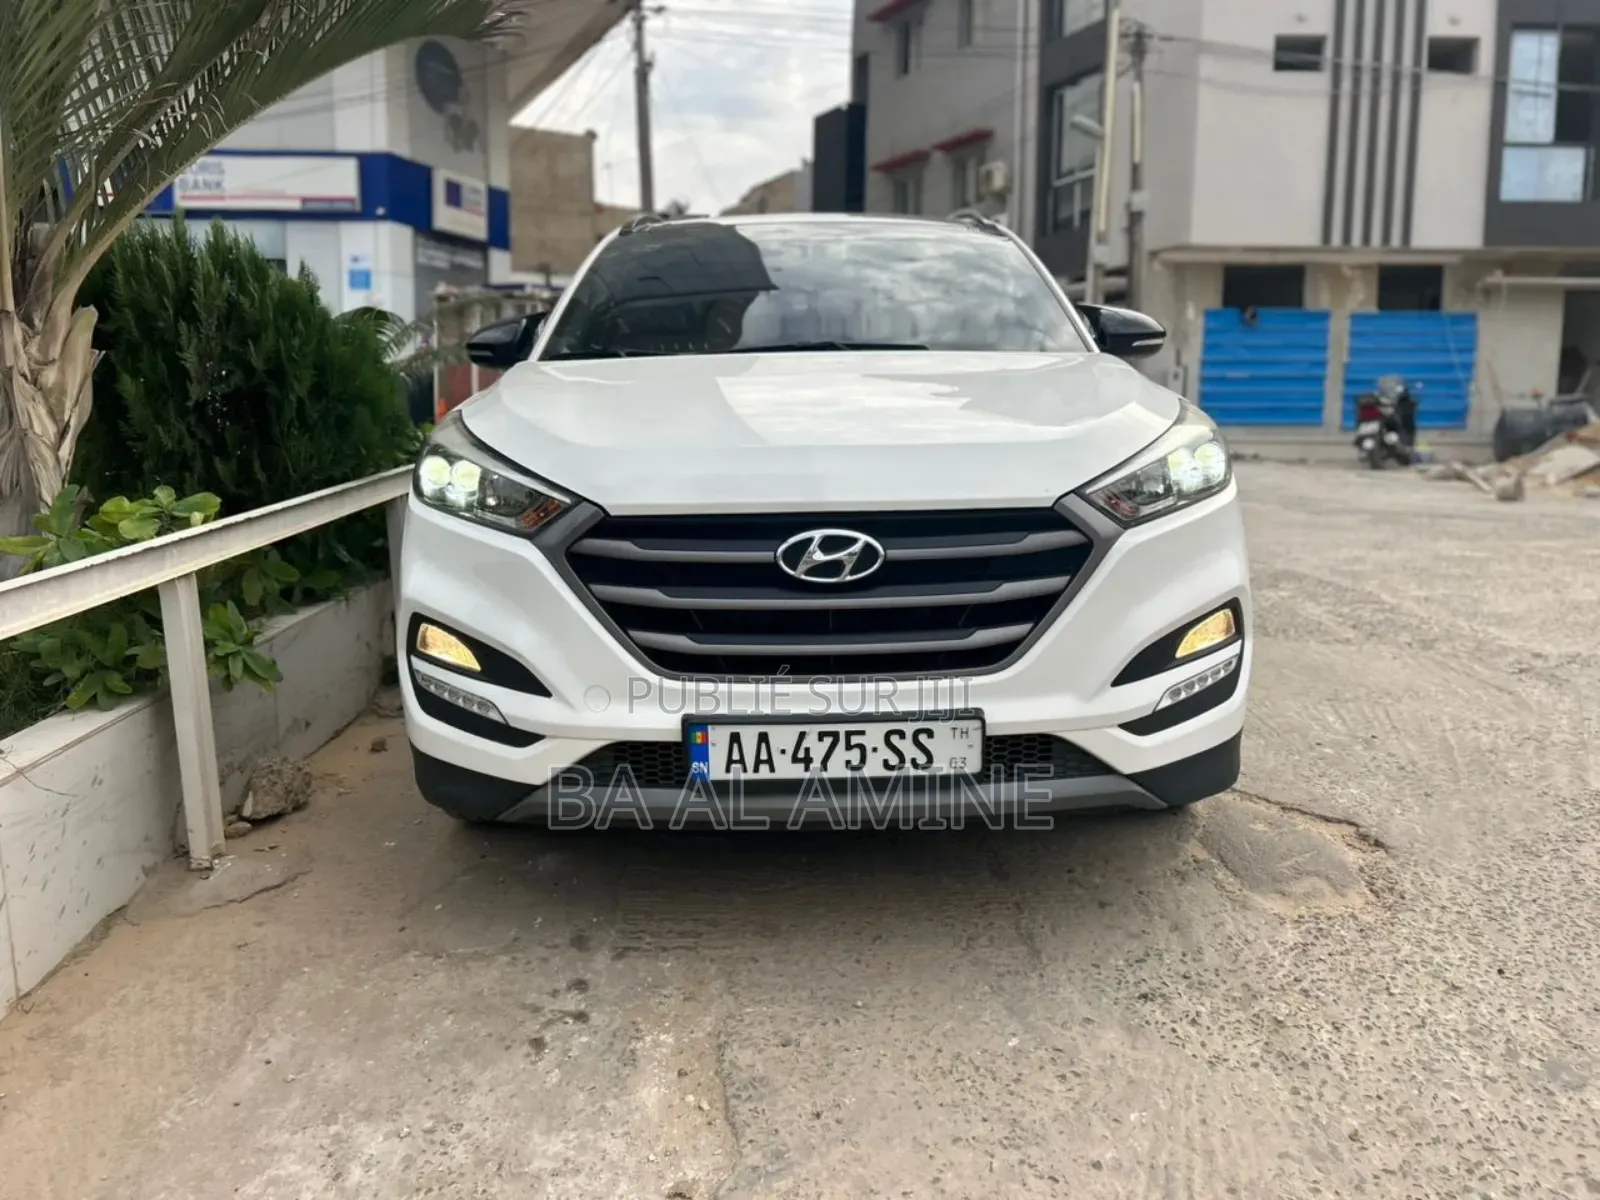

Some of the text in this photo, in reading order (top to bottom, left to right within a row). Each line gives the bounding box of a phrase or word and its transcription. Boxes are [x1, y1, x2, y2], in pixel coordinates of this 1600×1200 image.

[179, 177, 225, 192] BANK
[951, 727, 969, 739] TH
[692, 762, 708, 774] SN
